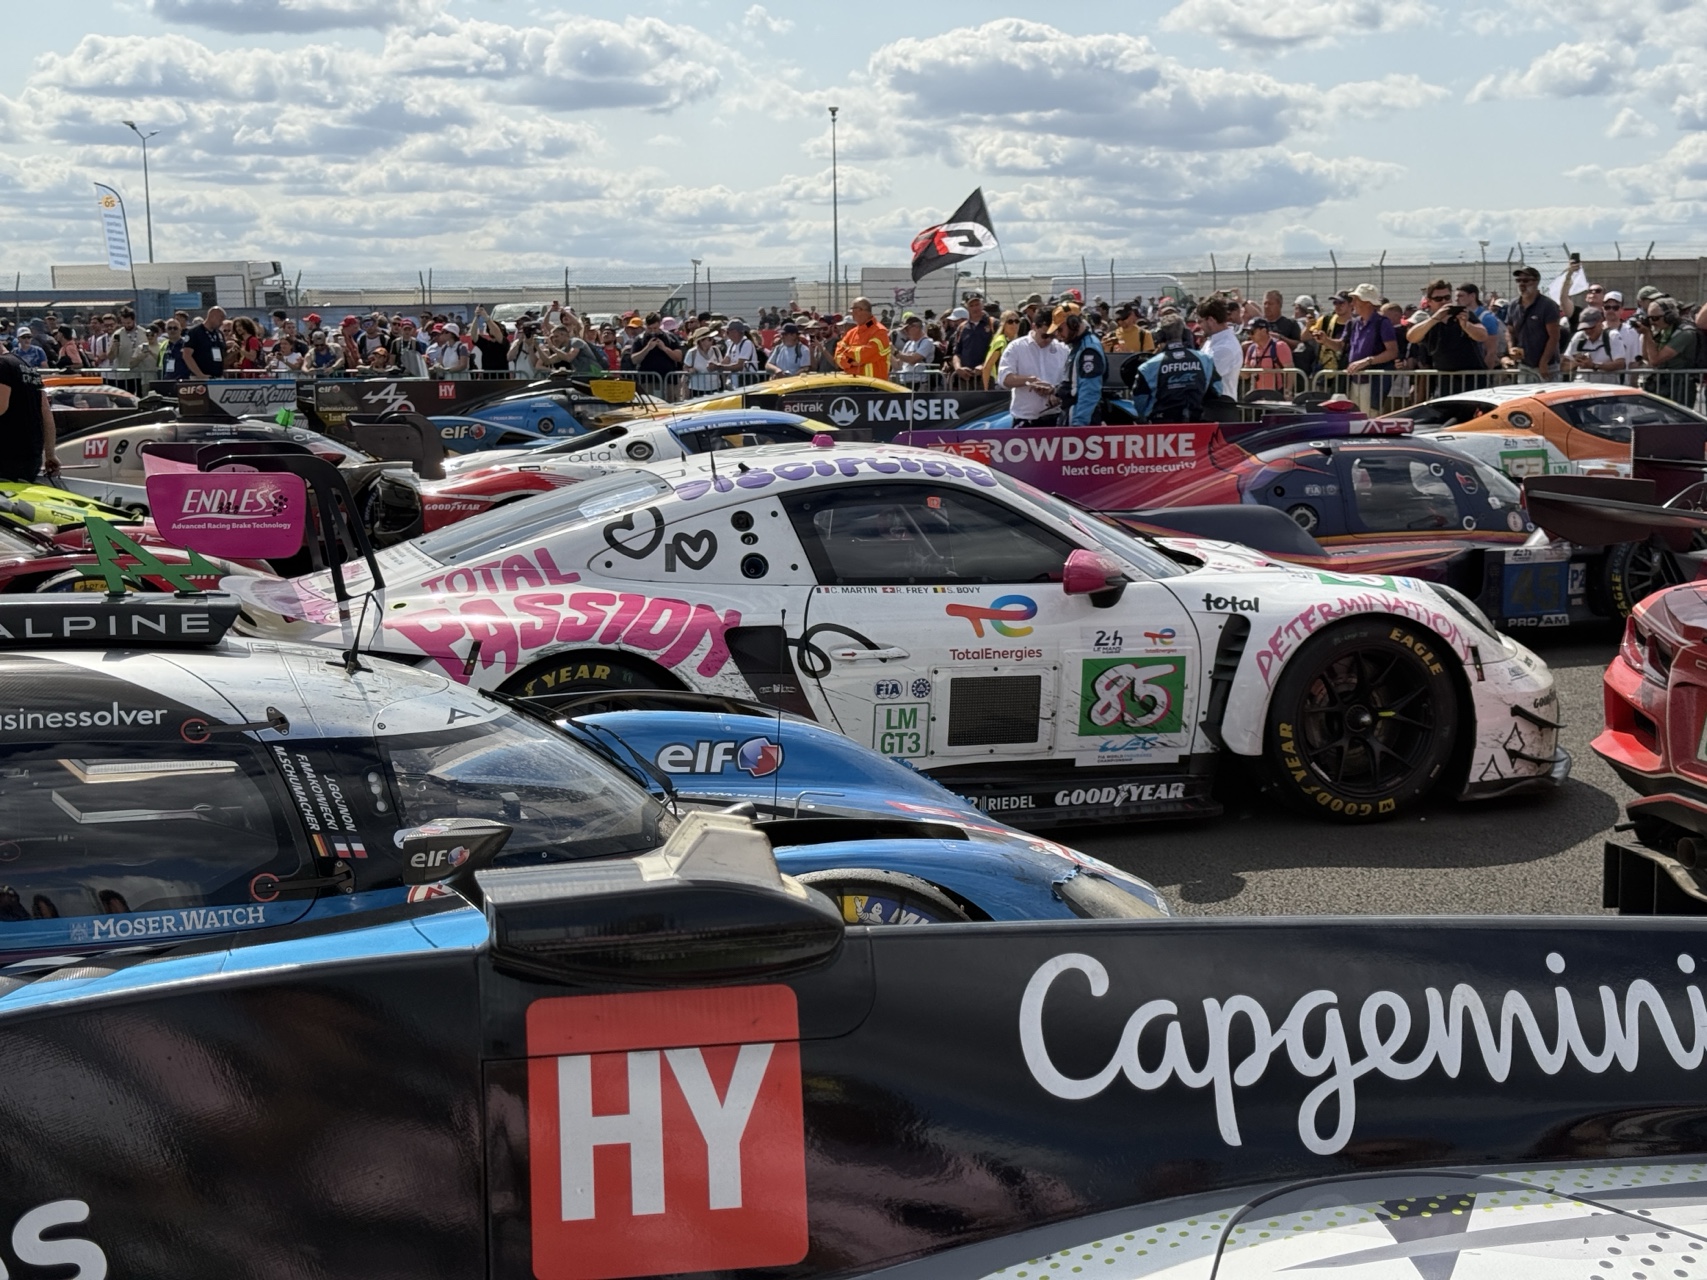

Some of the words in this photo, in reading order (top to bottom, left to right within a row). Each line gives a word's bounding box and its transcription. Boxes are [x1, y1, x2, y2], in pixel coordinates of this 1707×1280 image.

[1161, 362, 1201, 374] OFFICIAL
[180, 385, 196, 394] elf
[221, 388, 252, 403] PURE
[439, 385, 455, 397] HY
[784, 402, 823, 413] adtrak
[868, 399, 960, 421] KAISER
[441, 426, 468, 438] elf
[85, 439, 107, 455] HY
[569, 450, 611, 463] octa
[963, 433, 1195, 463] ROWDSTRIKE
[1062, 465, 1088, 476] Next
[1091, 464, 1114, 475] Gen
[1118, 460, 1197, 476] Cybersecurity
[182, 489, 282, 513] ENDLESS
[424, 502, 481, 512] GOODYEAR
[207, 523, 230, 531] Racing
[252, 522, 291, 530] Technology
[421, 547, 581, 601] TOTAL
[1571, 569, 1586, 590] P2
[1202, 593, 1259, 613] total
[384, 592, 742, 686] PASSION
[1256, 592, 1473, 691] DETERMINATION
[949, 646, 1043, 661] TotalEnergies
[1389, 627, 1444, 677] EAGLE
[1089, 663, 1178, 727] 85
[0, 702, 167, 730] sinessolver
[886, 708, 918, 730] LM
[880, 732, 921, 754] GT3
[657, 741, 736, 773] elf
[1279, 723, 1373, 816] GOODYEAR
[273, 745, 320, 831] M.SCHUMACHER
[296, 753, 339, 831] F.MAKOWIECKI
[1055, 782, 1186, 807] GOODYEAR
[323, 774, 357, 832] J.GOUNON
[988, 796, 1035, 811] RIEDEL
[410, 850, 448, 868] elf
[556, 1043, 776, 1222] HY
